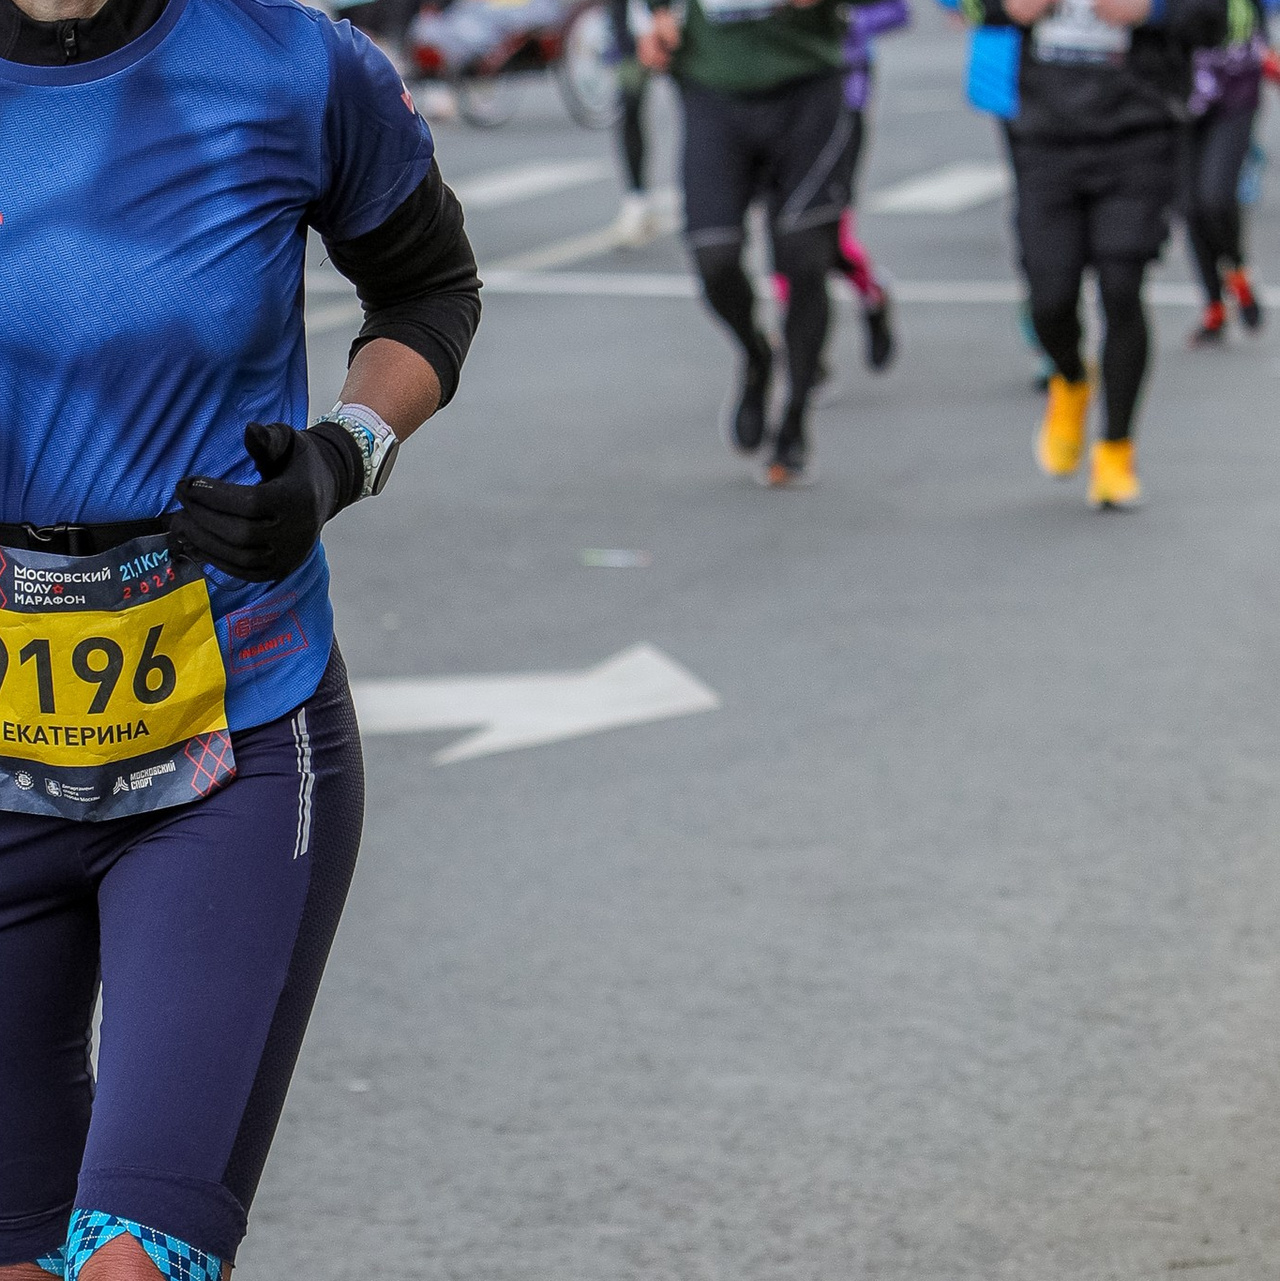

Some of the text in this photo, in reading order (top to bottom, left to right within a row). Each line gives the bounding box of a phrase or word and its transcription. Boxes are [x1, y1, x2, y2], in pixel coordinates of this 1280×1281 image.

[14, 565, 111, 583] МОСКОВСКИЙ
[14, 580, 51, 594] ПОЛУ
[14, 593, 86, 606] МАРАФОН
[3, 720, 150, 747] ЕКАТЕРИНА
[130, 760, 176, 780] МОСКОВСКИЙ
[130, 777, 153, 790] СПОРТ
